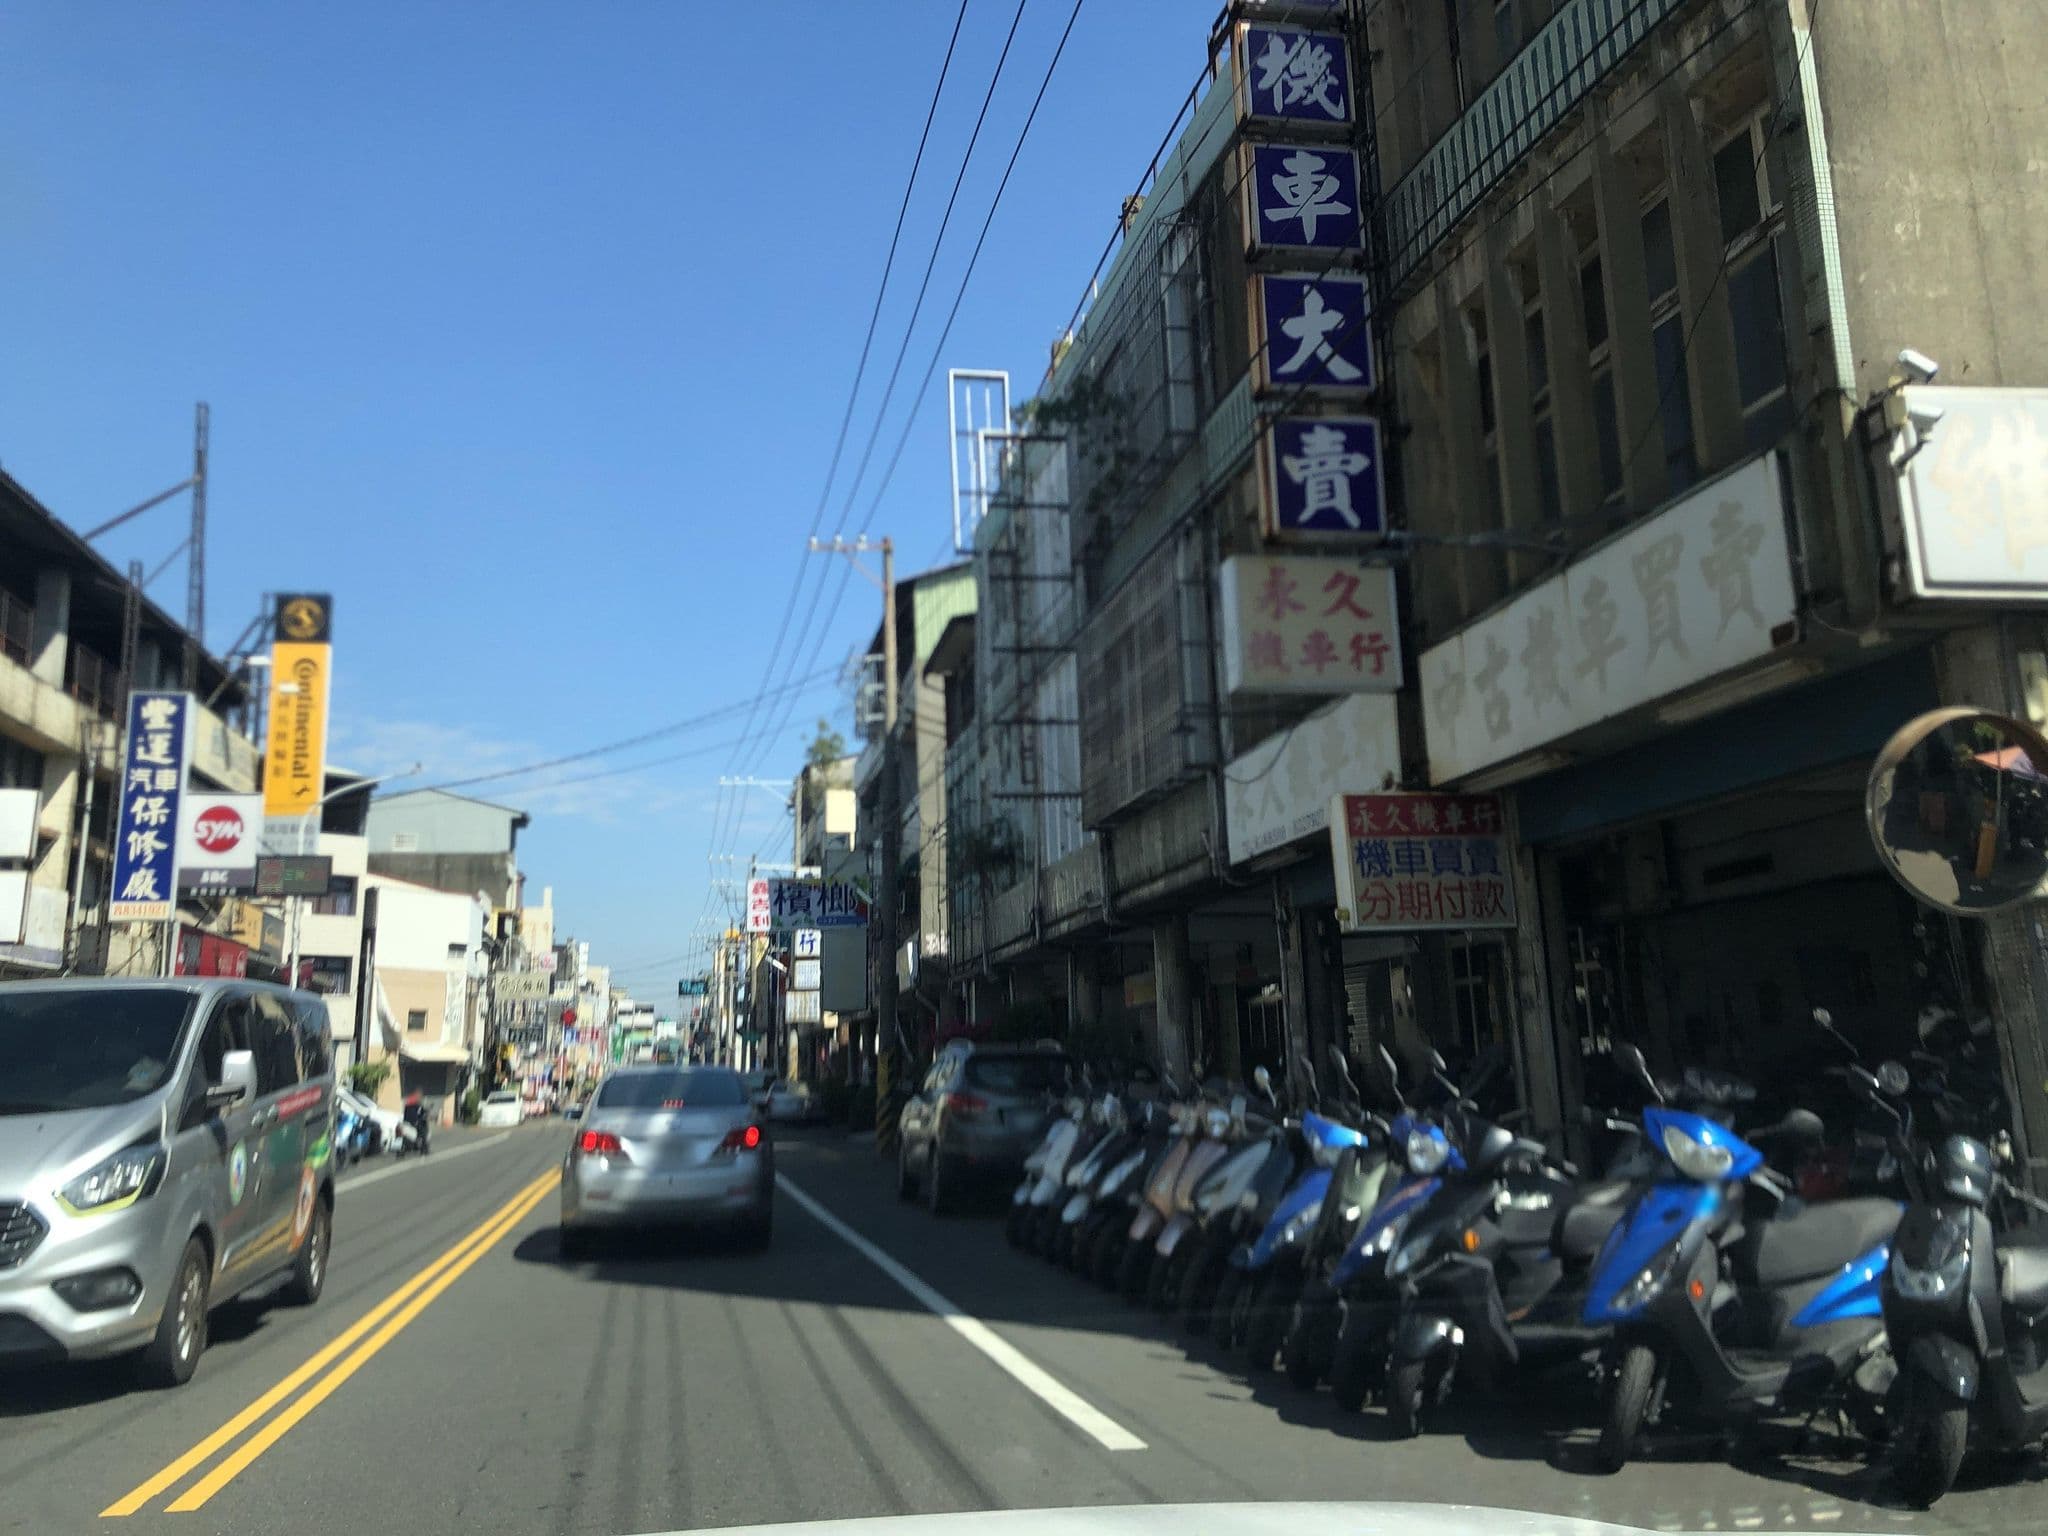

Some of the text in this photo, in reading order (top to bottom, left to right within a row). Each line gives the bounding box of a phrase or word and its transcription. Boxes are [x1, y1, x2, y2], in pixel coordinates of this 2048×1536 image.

[1255, 567, 1373, 620] 永久
[1247, 629, 1390, 676] 機車行
[292, 657, 318, 779] Continental
[195, 820, 242, 845] SYM
[1352, 800, 1501, 833] 永久機車行
[1354, 839, 1502, 878] 機車買賣
[773, 880, 857, 917] 檳榔
[1358, 879, 1505, 922] 分期付款
[800, 932, 817, 954] 行
